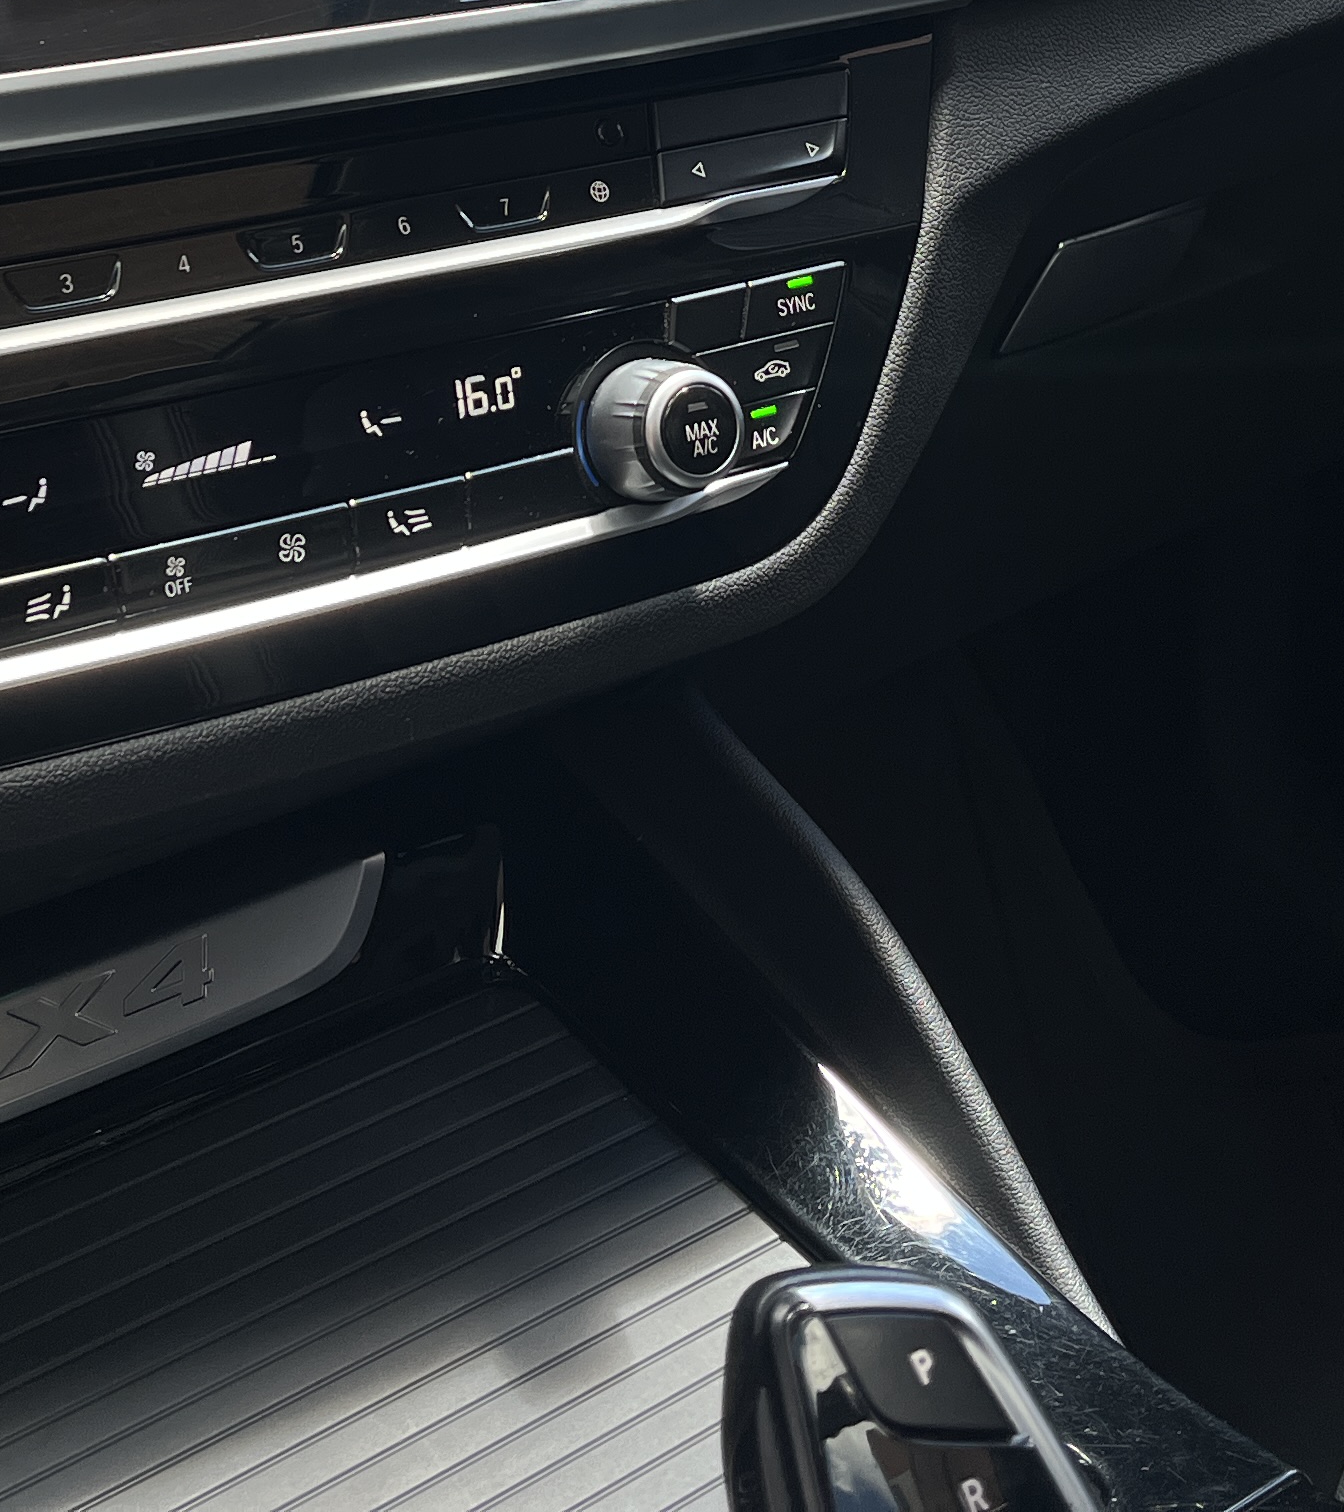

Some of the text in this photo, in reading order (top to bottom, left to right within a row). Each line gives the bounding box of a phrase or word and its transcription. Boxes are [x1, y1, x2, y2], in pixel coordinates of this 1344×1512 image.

[500, 198, 511, 217] 7
[397, 216, 411, 236] 6
[291, 234, 304, 254] 5
[178, 255, 191, 275] 4
[60, 274, 74, 294] 3
[777, 292, 816, 317] SYNC
[685, 418, 720, 442] MAX
[752, 426, 780, 450] A/C
[693, 435, 718, 457] A/C
[164, 575, 193, 598] OFF
[908, 1348, 935, 1386] P
[960, 1477, 991, 1512] R
